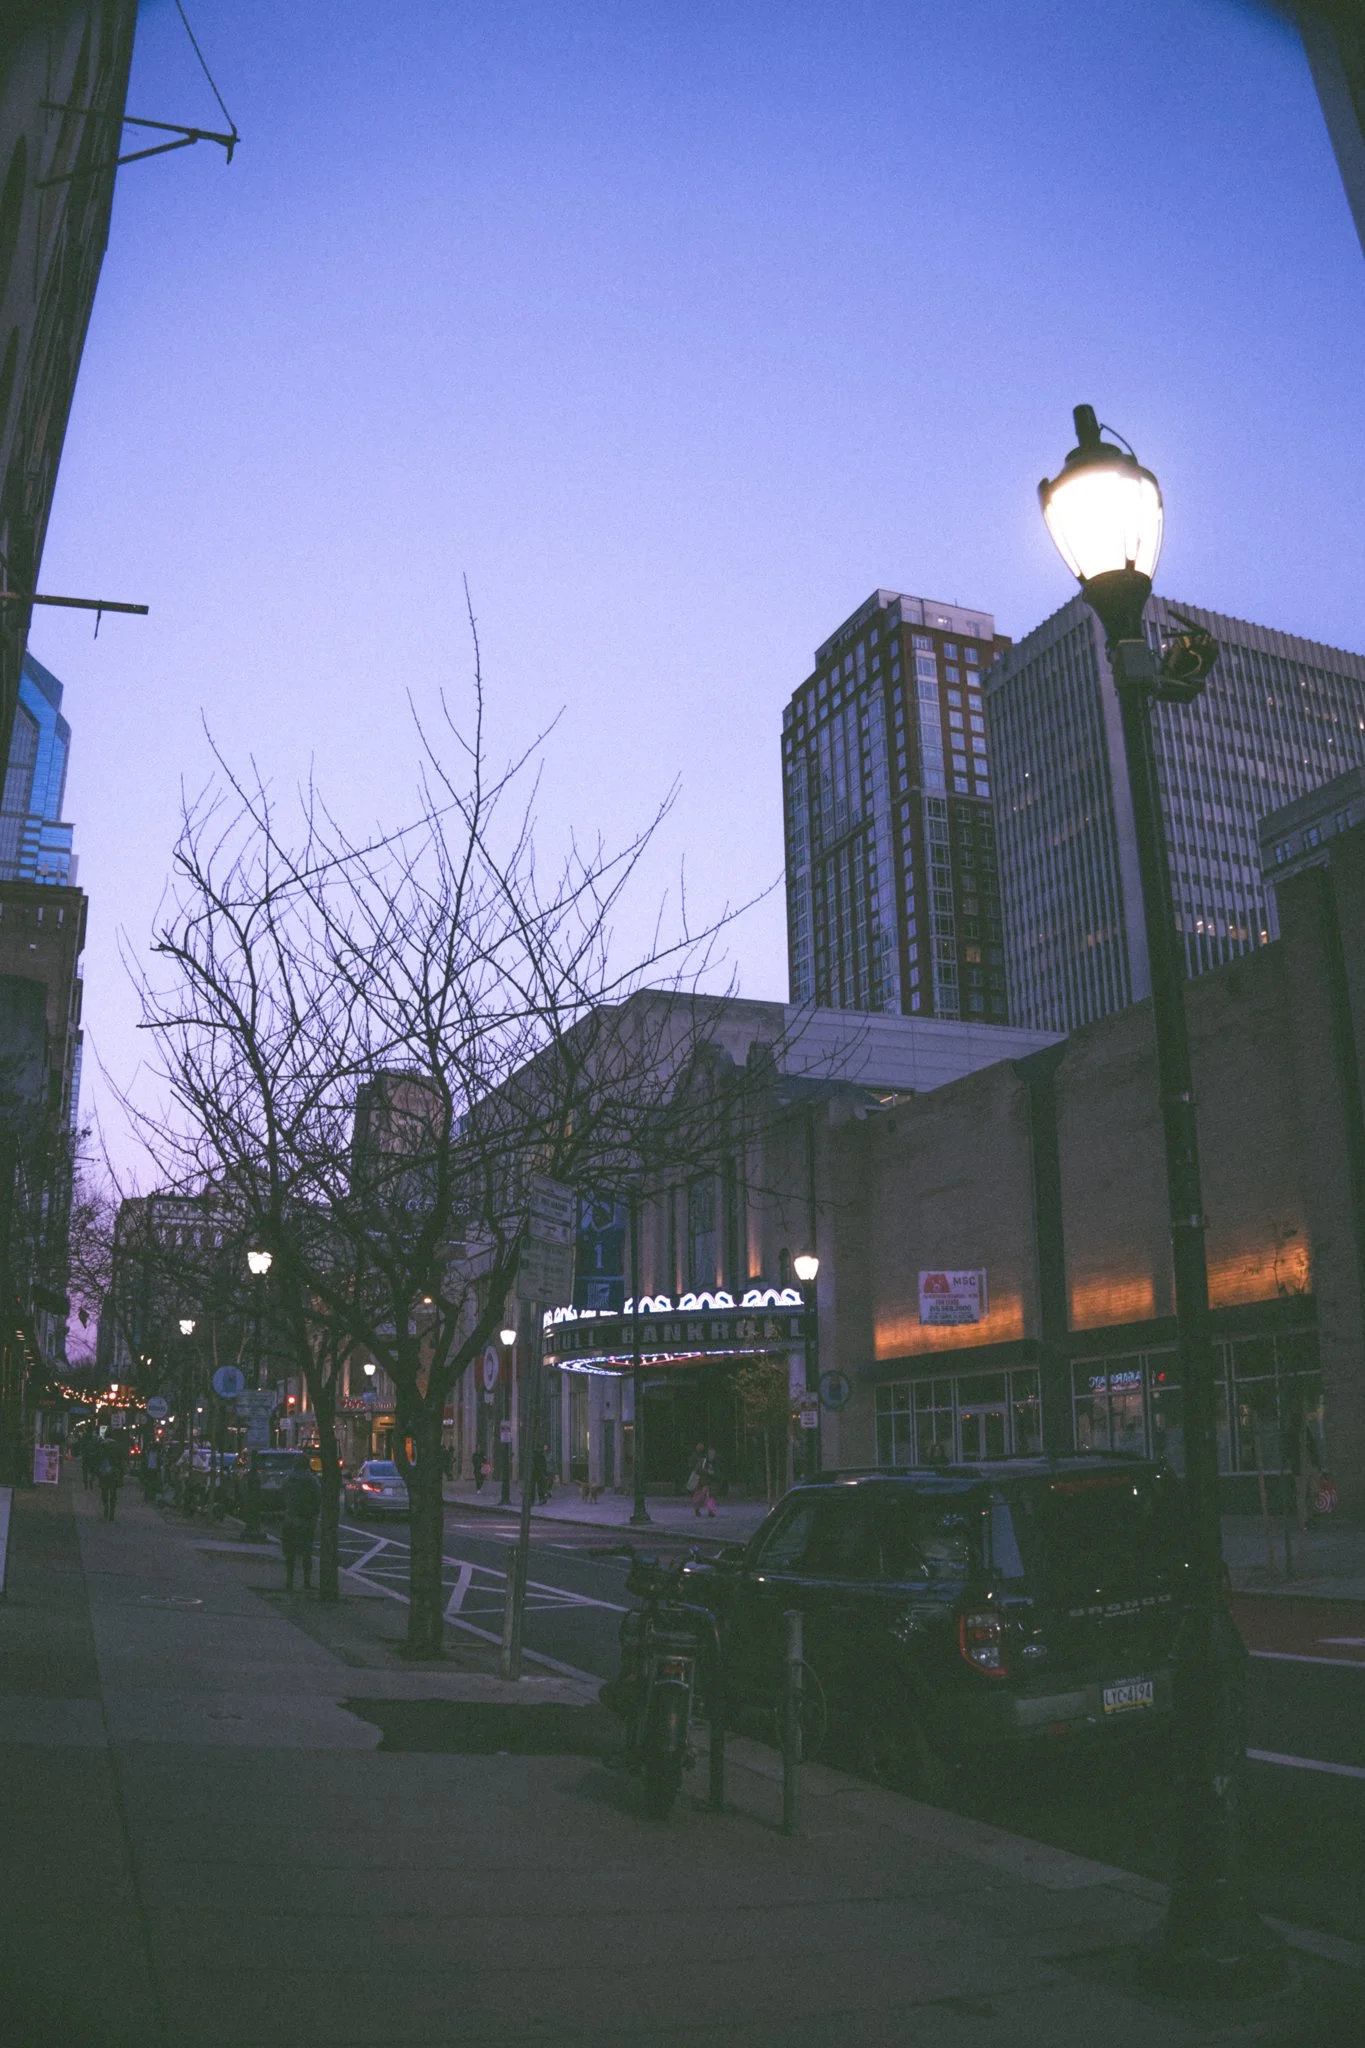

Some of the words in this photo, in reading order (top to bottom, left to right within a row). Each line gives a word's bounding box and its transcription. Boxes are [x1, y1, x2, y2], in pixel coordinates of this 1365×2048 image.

[953, 1276, 976, 1286] MSC
[621, 1318, 804, 1344] BANKROLL
[1069, 1594, 1171, 1617] BRONCO
